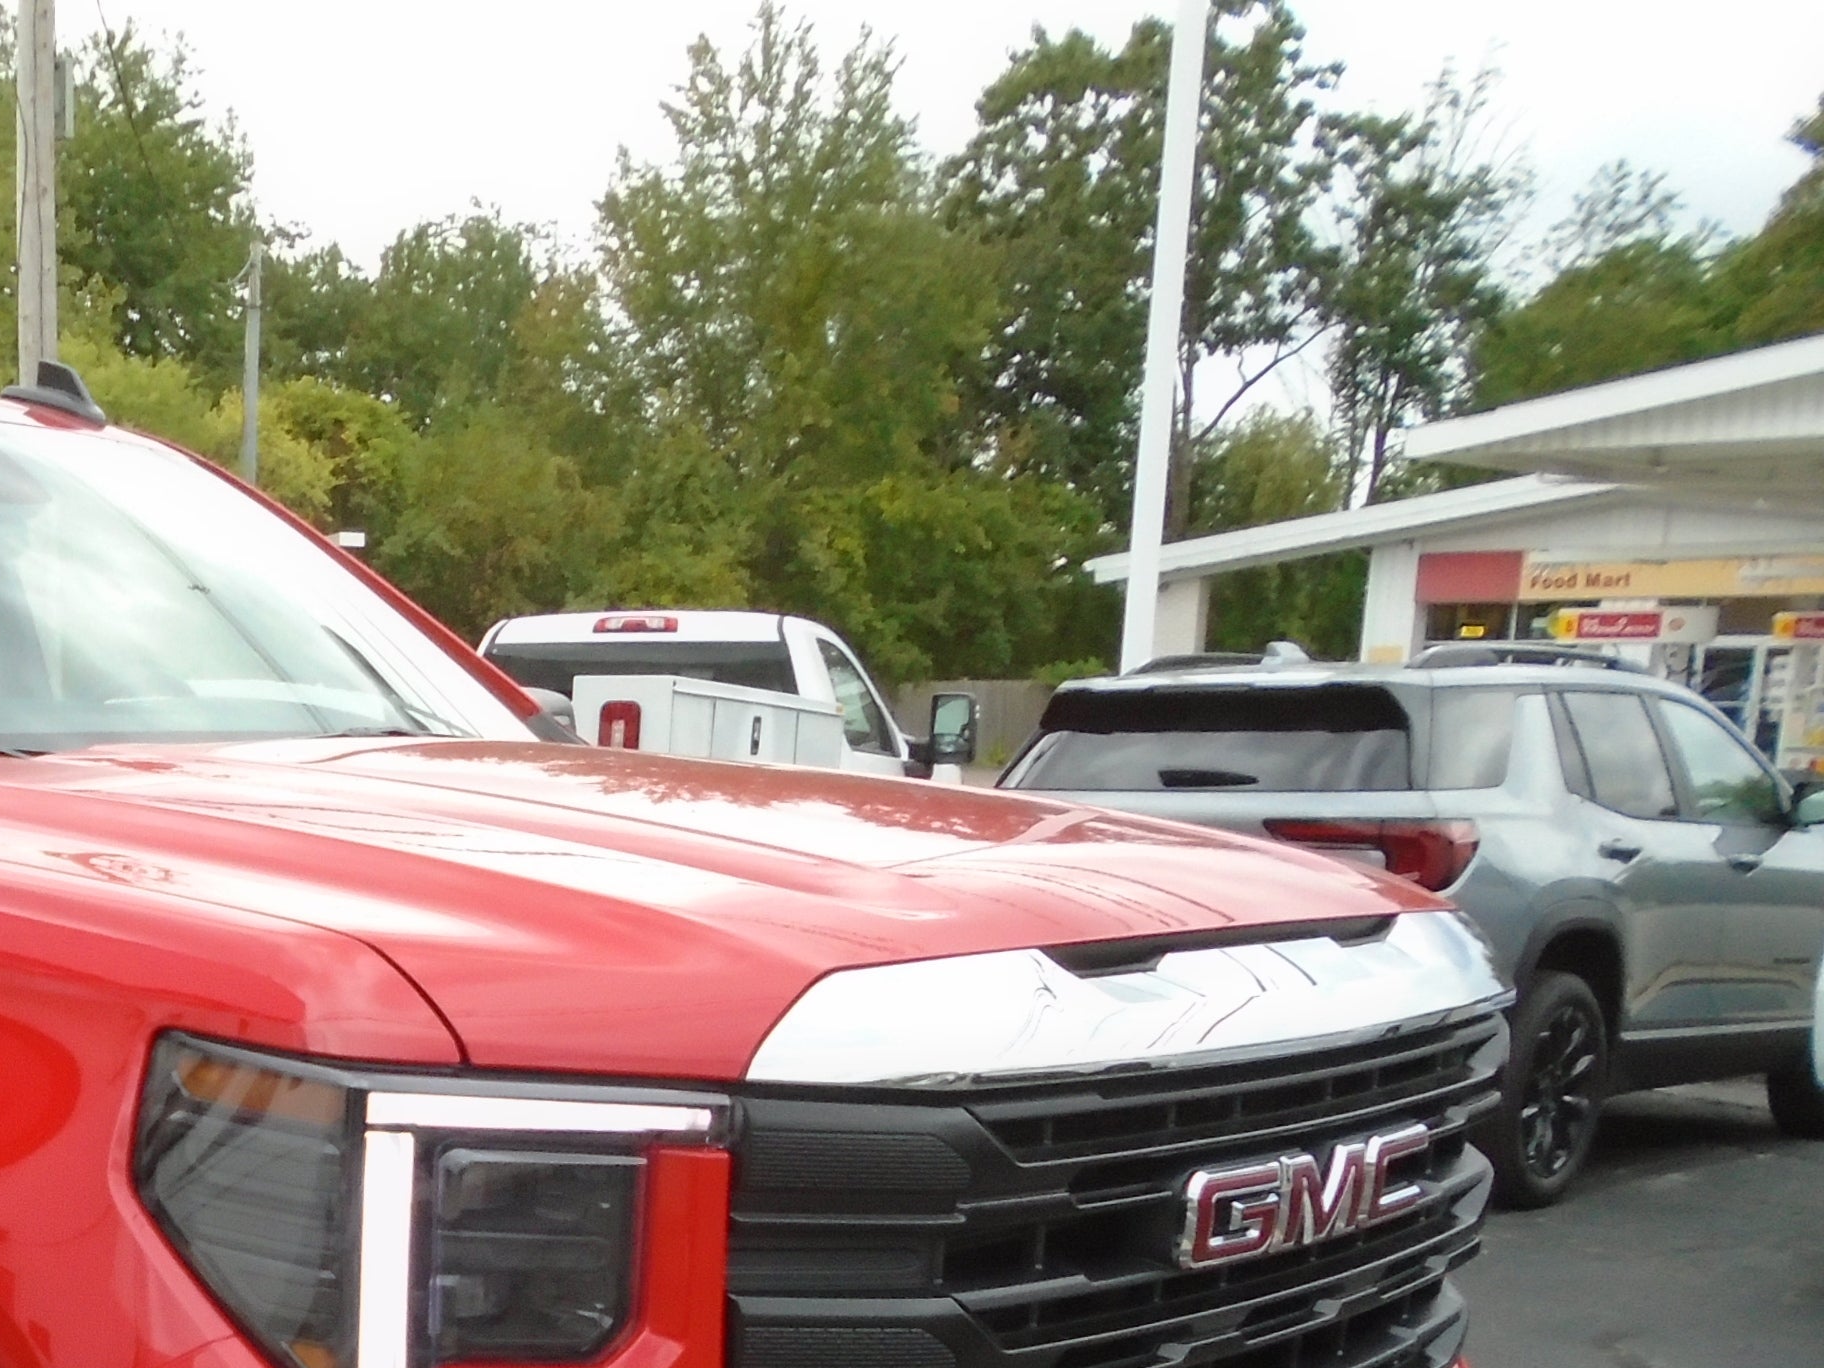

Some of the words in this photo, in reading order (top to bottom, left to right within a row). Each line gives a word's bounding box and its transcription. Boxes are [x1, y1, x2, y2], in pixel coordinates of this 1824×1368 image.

[1530, 573, 1578, 590] Food
[1585, 572, 1630, 588] Mart
[1179, 1123, 1429, 1270] GMC
